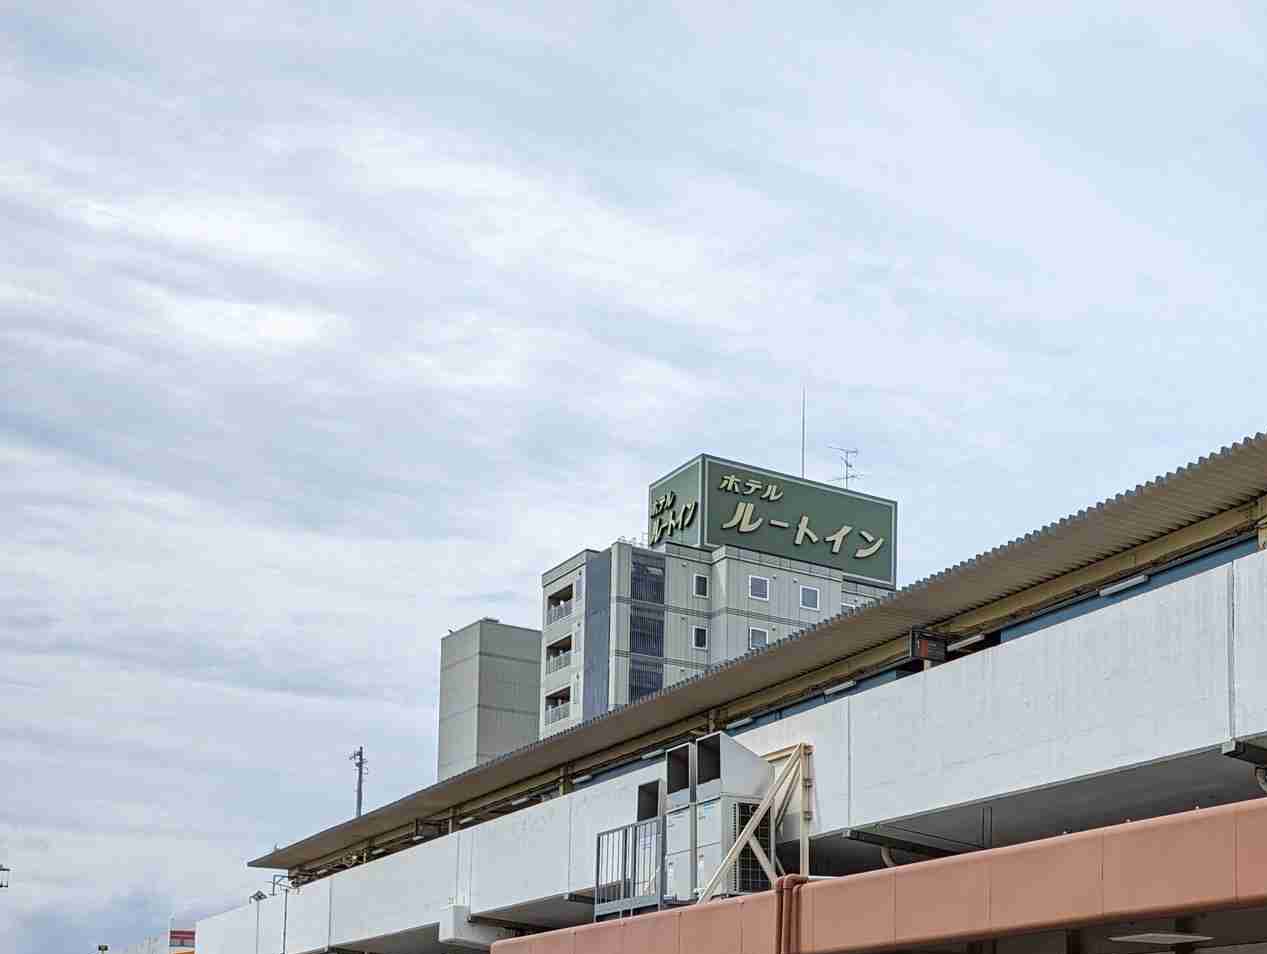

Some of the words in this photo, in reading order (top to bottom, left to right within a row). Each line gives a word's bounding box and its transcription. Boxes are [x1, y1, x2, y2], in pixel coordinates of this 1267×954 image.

[719, 475, 784, 501] ホテル
[721, 502, 885, 559] ルートイン
